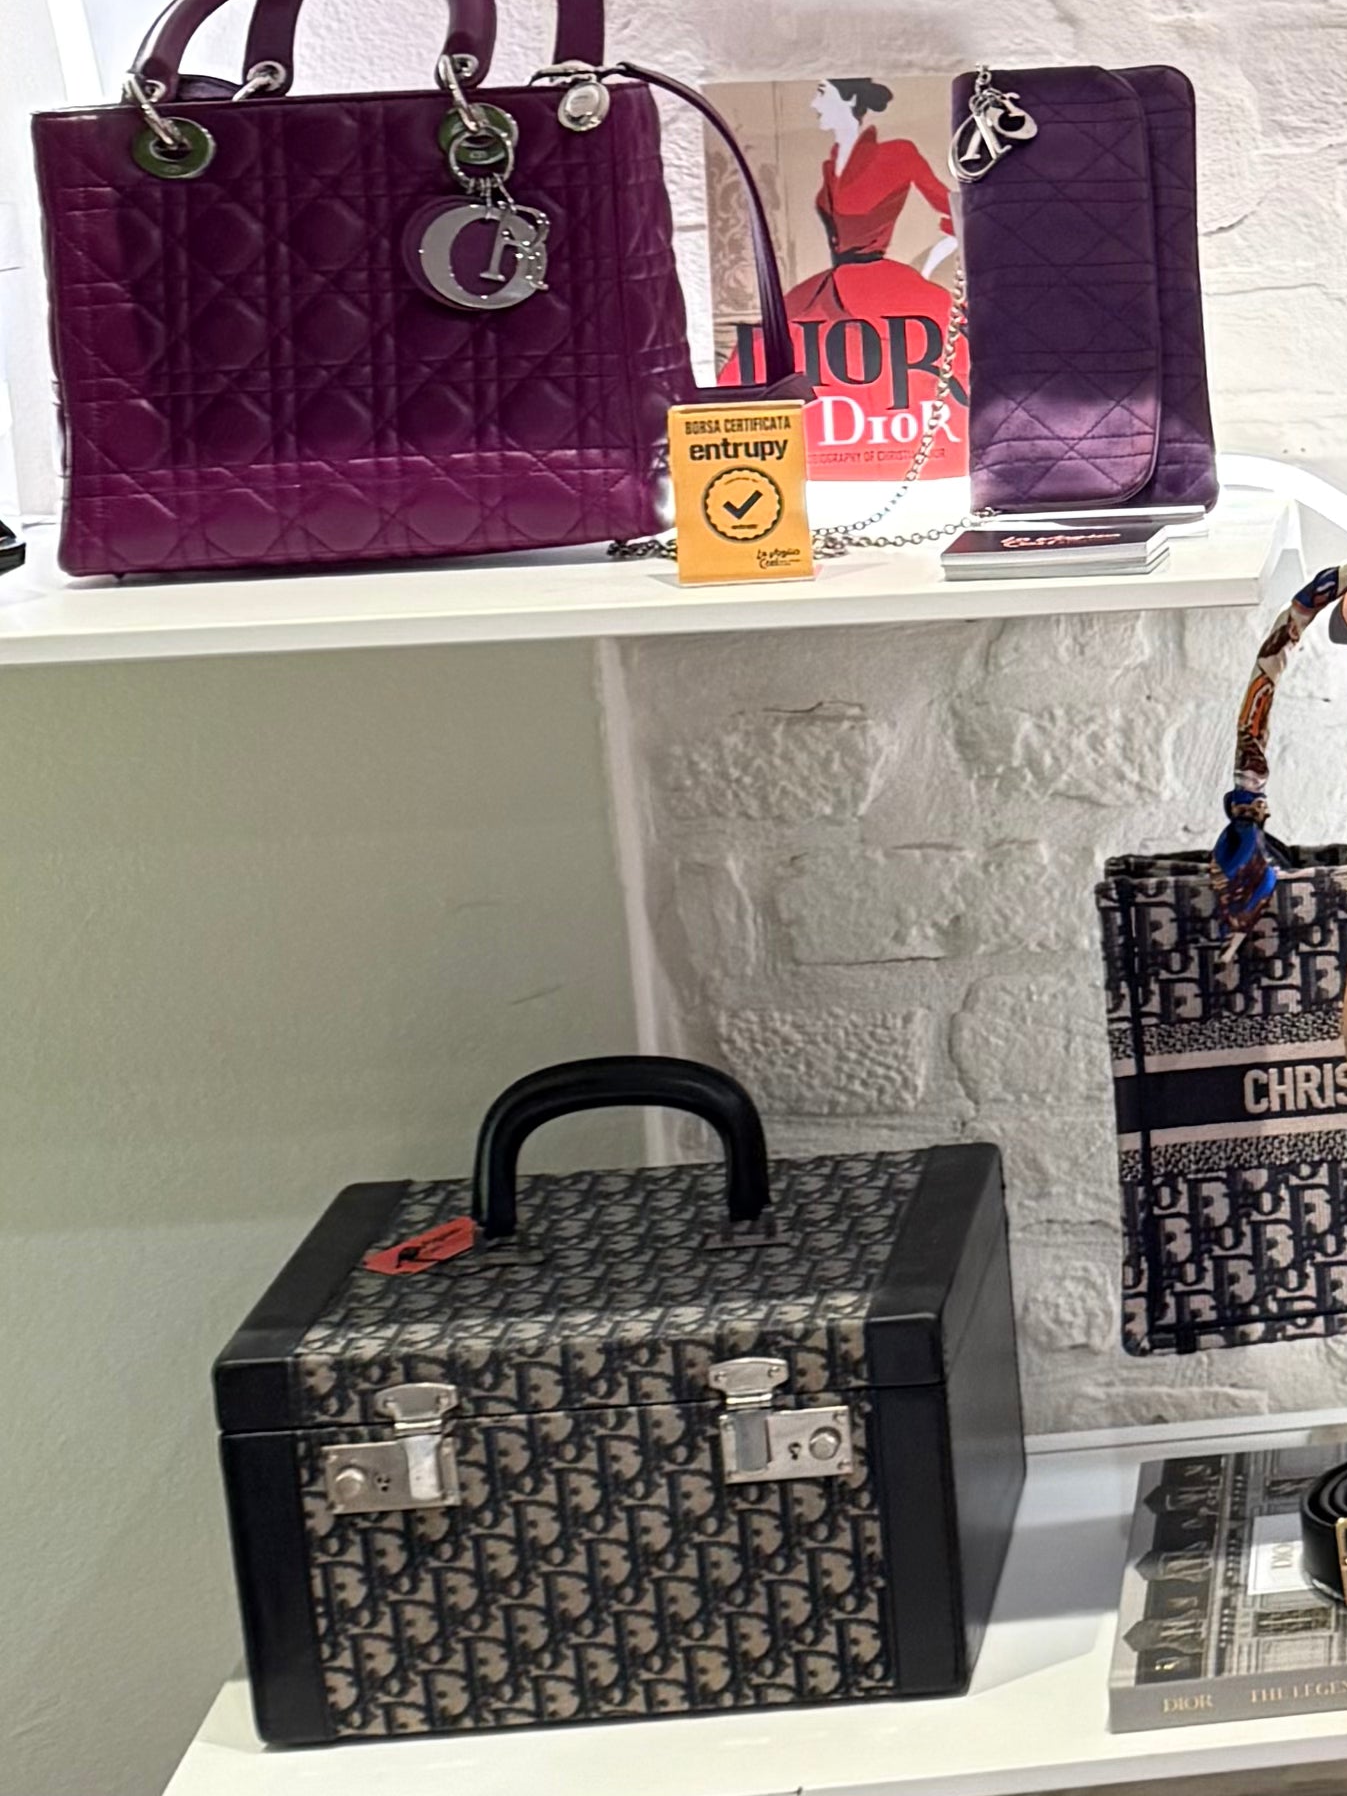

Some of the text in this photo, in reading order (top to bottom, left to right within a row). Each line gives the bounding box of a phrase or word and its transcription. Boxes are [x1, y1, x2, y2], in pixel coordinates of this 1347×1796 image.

[684, 415, 792, 435] BORSA CERTIFICATA
[688, 437, 789, 462] entrupy
[1162, 1692, 1214, 1714] DIOR
[1250, 1686, 1284, 1704] THE
